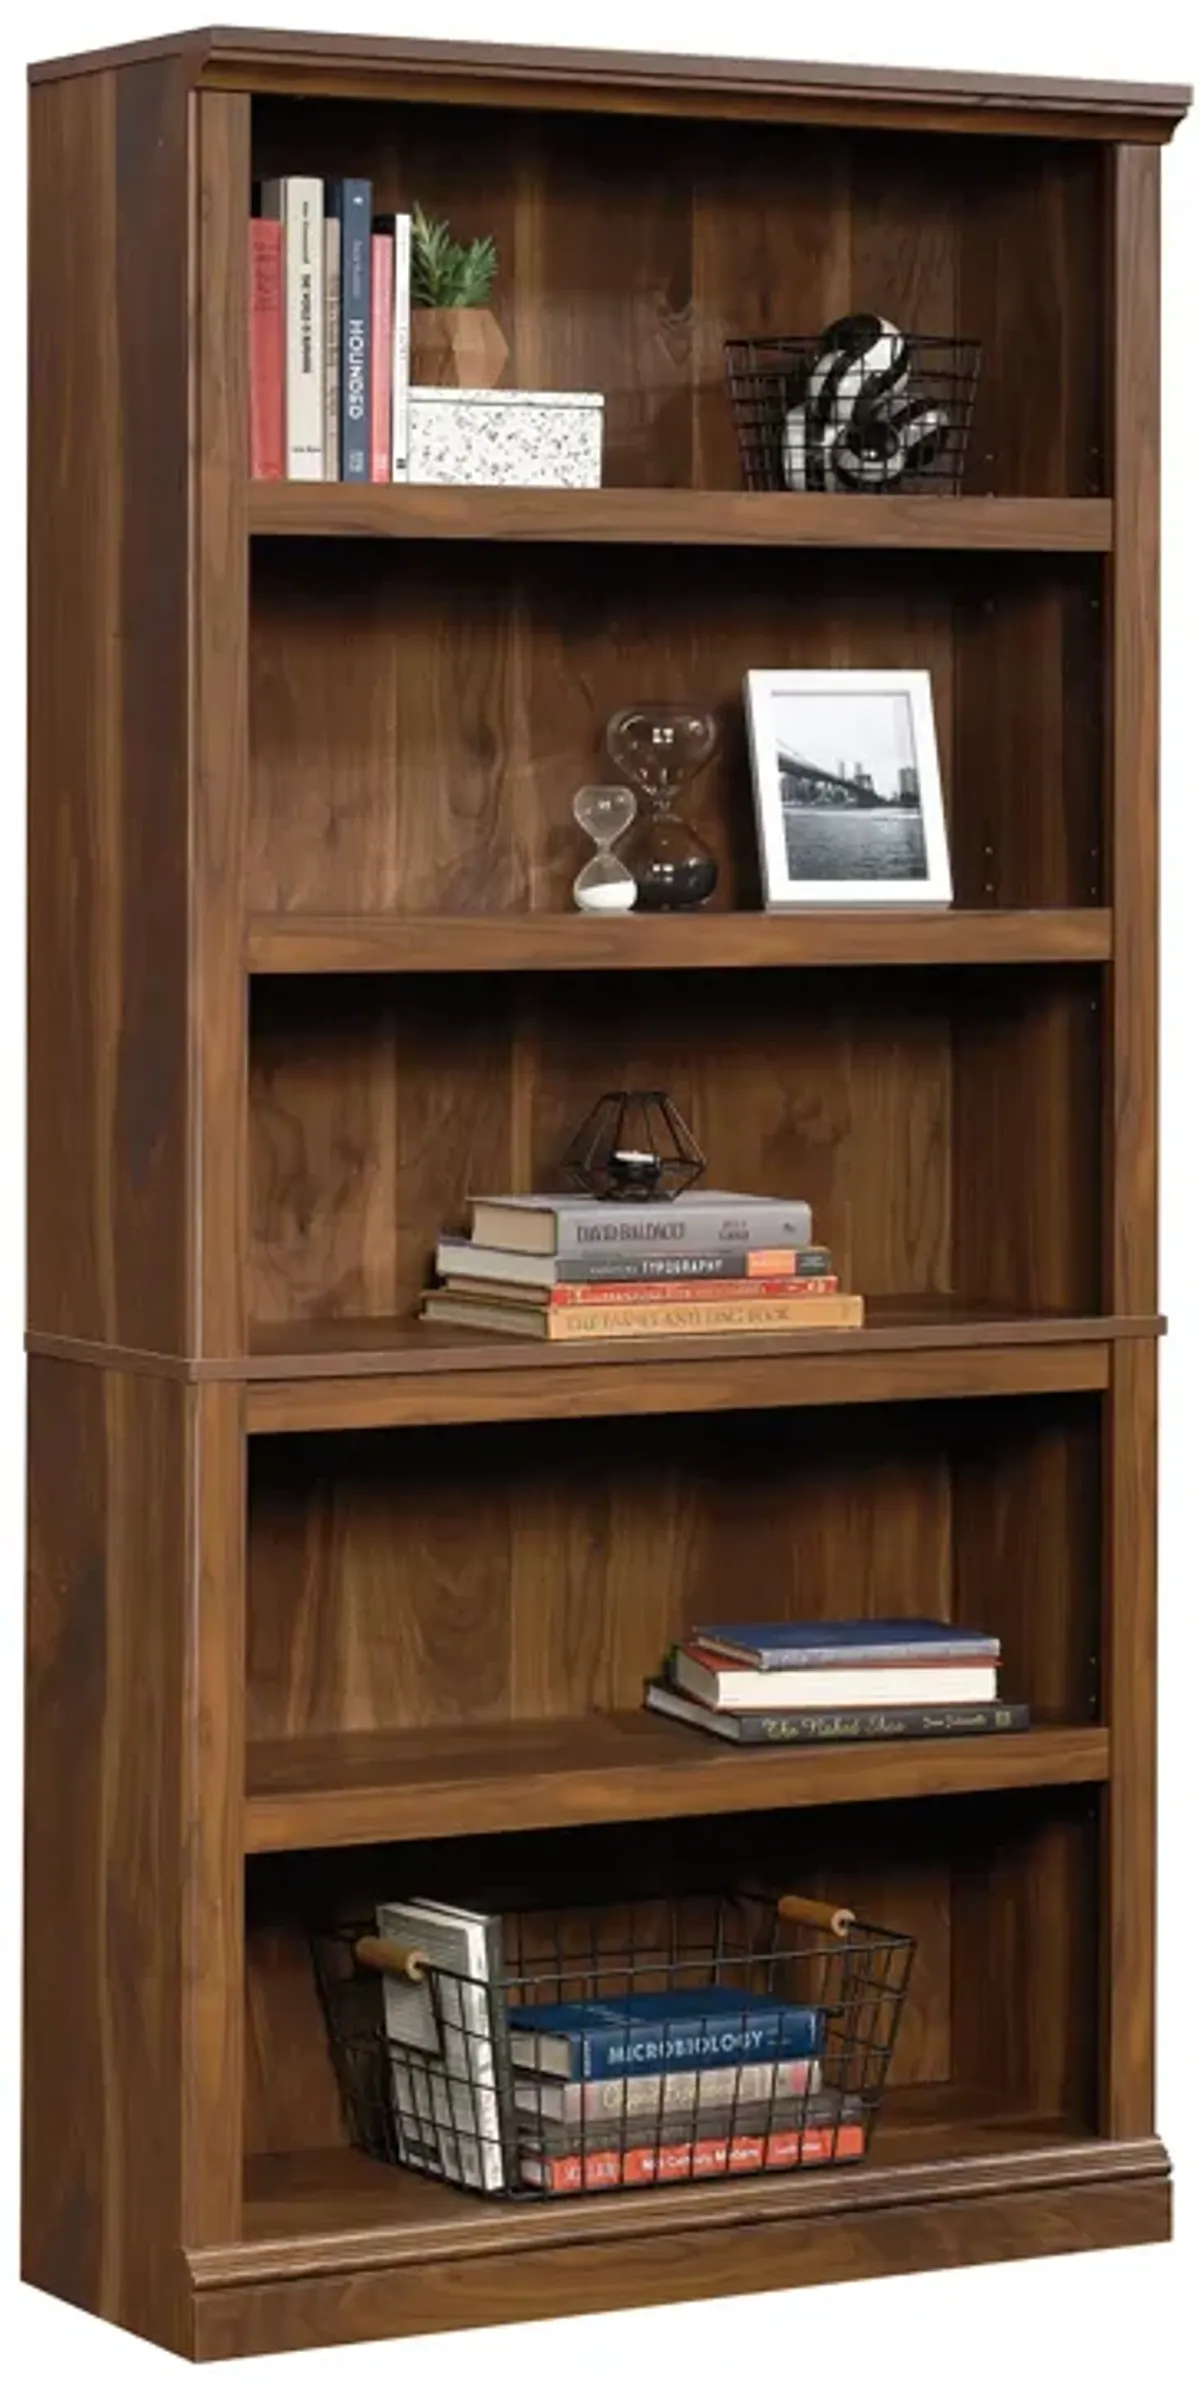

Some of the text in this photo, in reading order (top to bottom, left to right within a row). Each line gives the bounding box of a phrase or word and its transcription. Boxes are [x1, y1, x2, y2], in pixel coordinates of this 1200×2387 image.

[349, 318, 365, 420] HOUNDED
[642, 1259, 724, 1275] TYPOGRAPHY
[607, 2030, 764, 2065] MICROBIOLOGY
